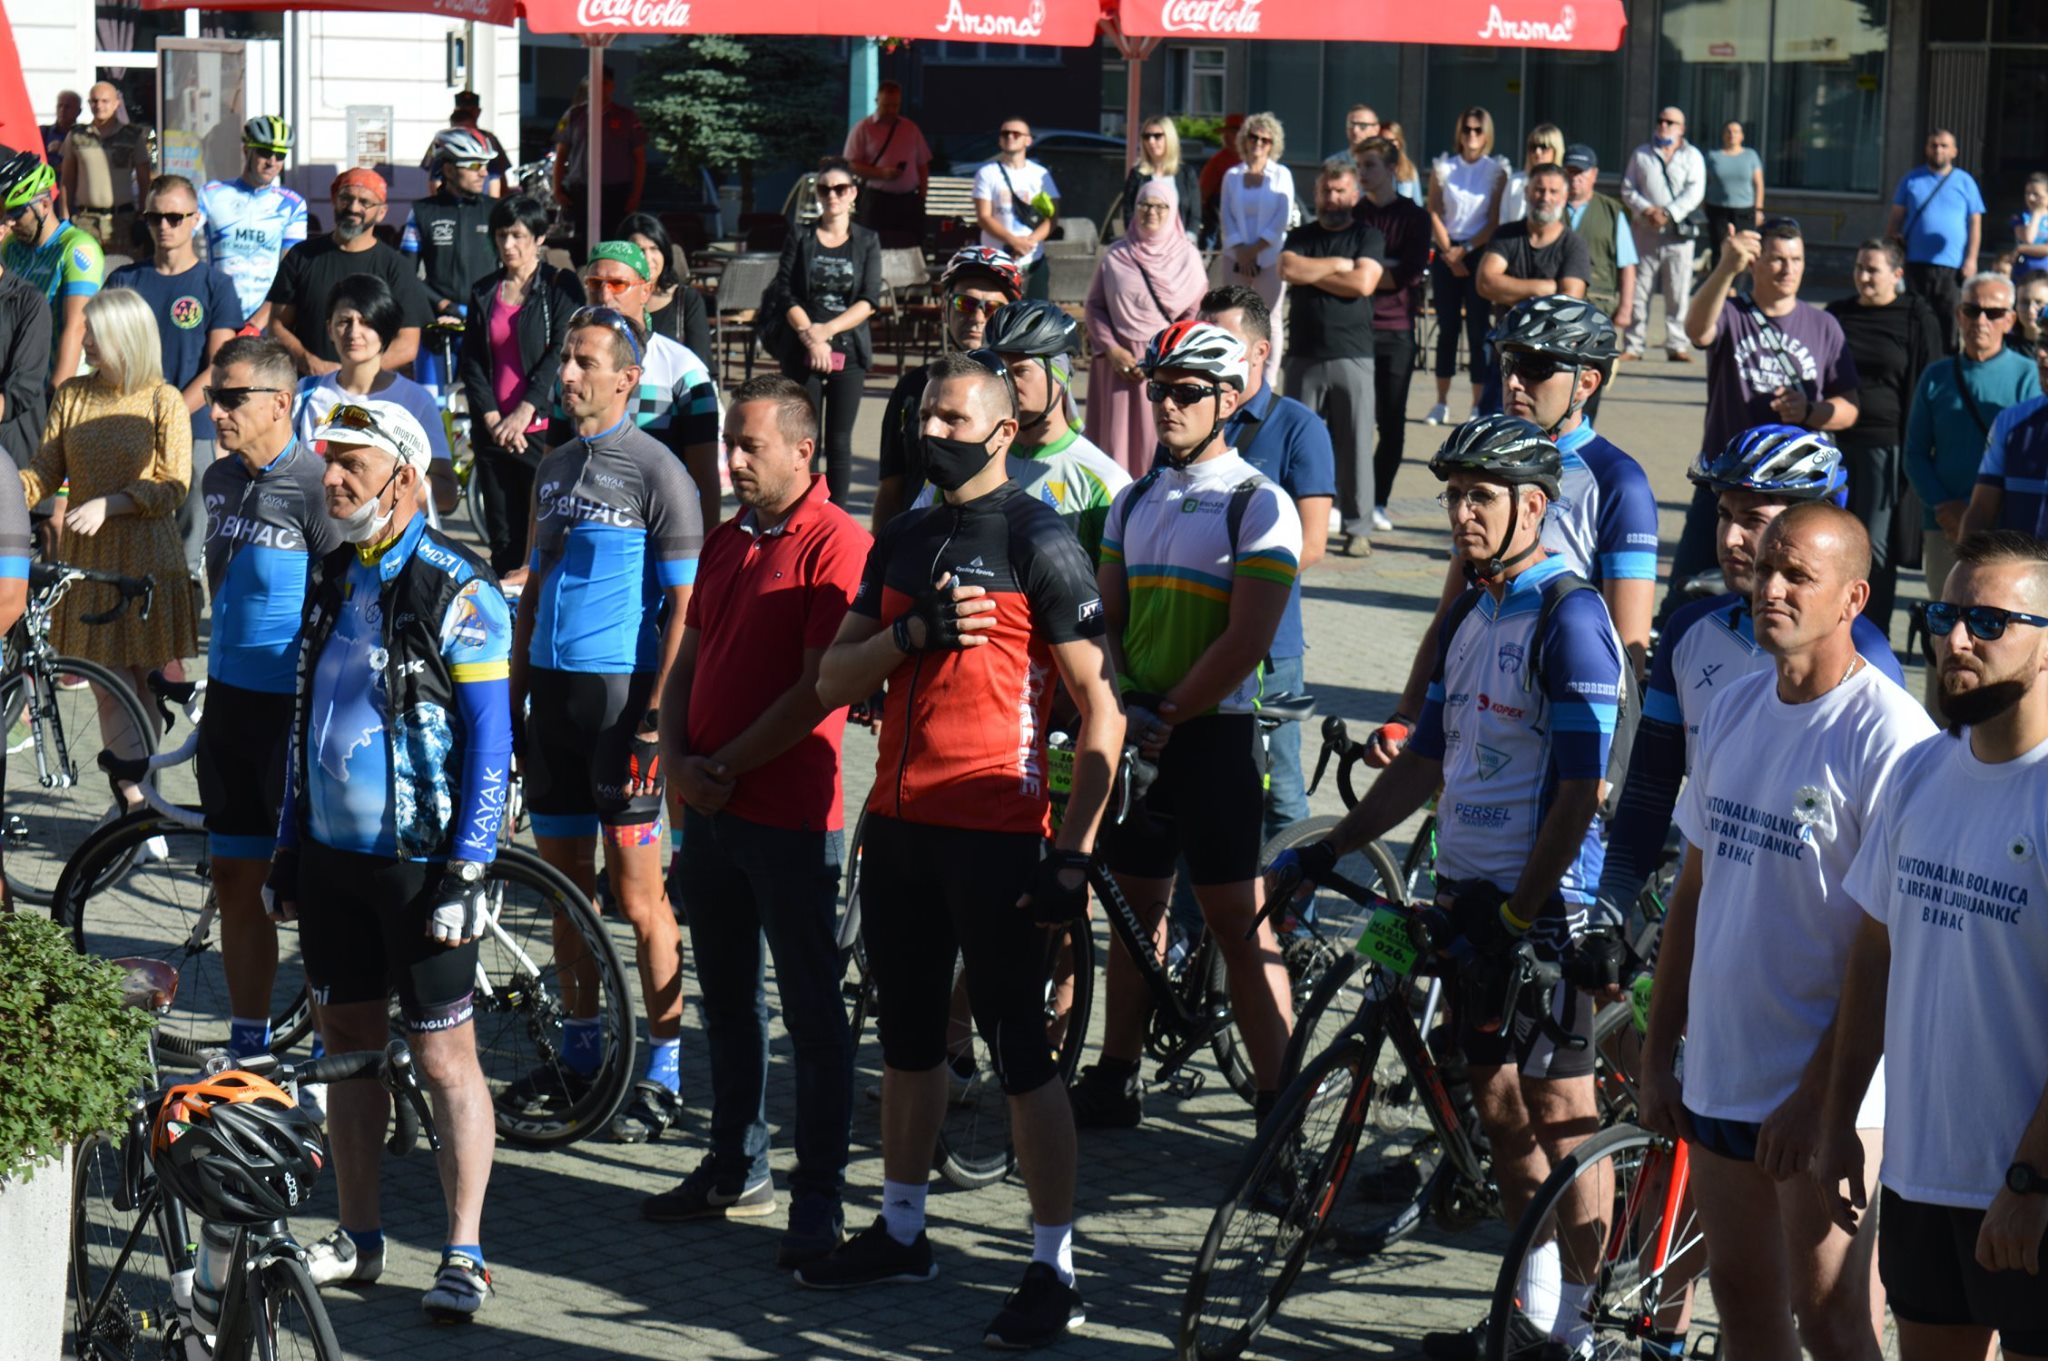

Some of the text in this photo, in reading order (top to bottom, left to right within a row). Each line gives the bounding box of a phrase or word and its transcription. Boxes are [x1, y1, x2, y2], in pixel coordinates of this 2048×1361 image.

[936, 0, 1042, 37] Aroma
[1479, 4, 1574, 42] Aroma
[235, 227, 267, 243] MTB
[1490, 702, 1525, 719] KOPEX
[1018, 659, 1050, 799] XTREME
[465, 767, 503, 849] KAYAK
[1455, 803, 1512, 821] PERSEL
[1717, 842, 1755, 866] BIHAĆ
[1907, 879, 1943, 903] IRFAN
[1965, 873, 2028, 906] BOLNICA
[1097, 862, 1163, 973] SPECIALIZED
[1922, 906, 1965, 931] BIHAĆ
[411, 1016, 456, 1030] MAGLIA
